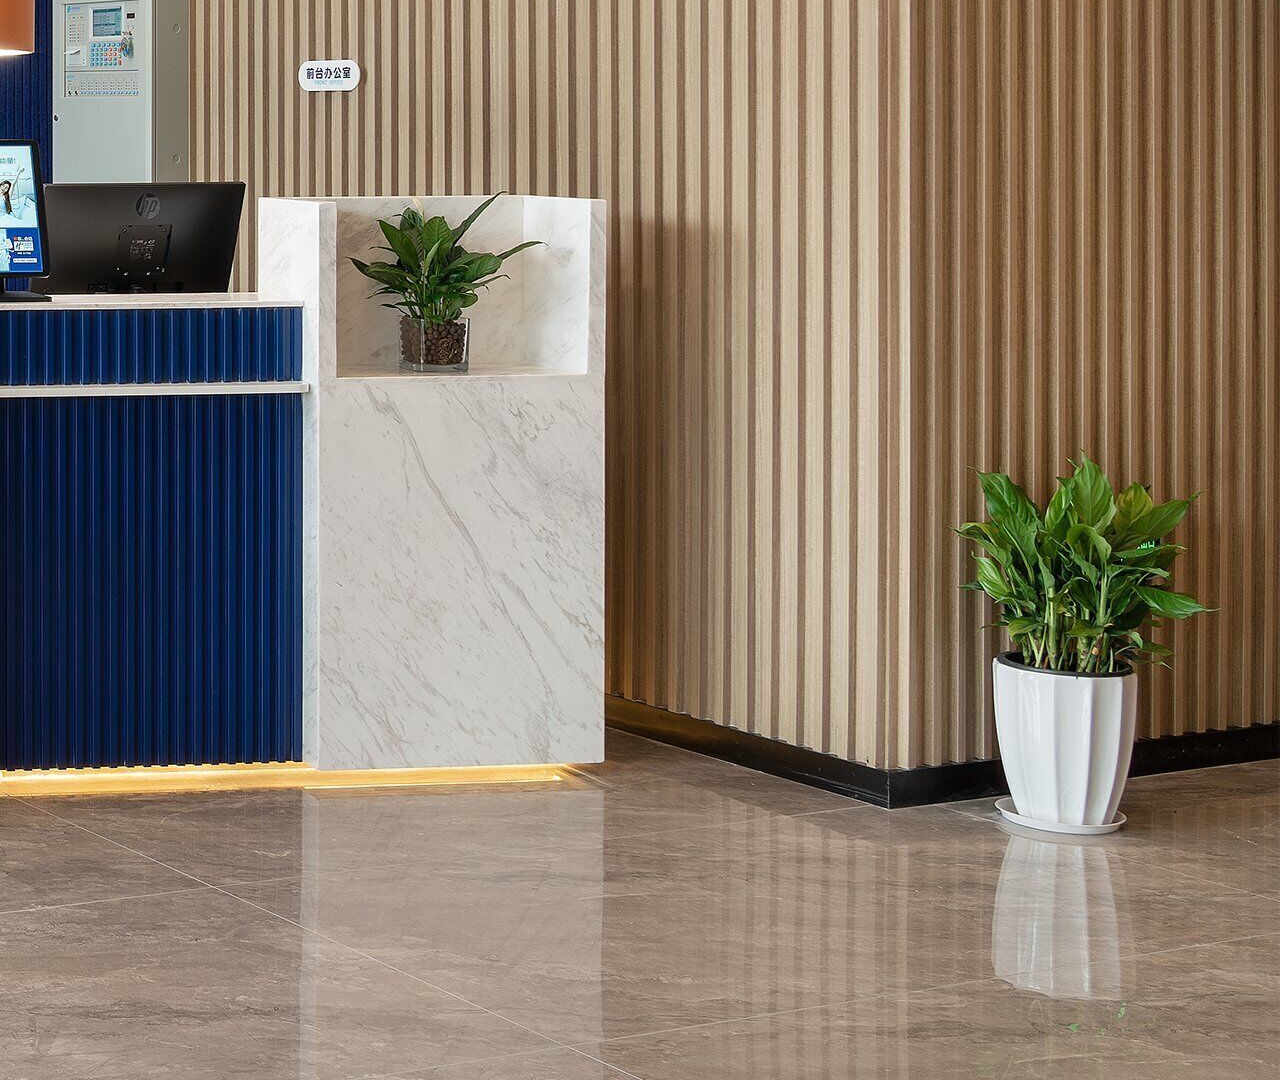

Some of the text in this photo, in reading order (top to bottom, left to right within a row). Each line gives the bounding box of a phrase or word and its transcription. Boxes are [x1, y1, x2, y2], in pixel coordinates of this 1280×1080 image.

[306, 67, 351, 79] 前台办公室
[136, 194, 160, 220] hp
